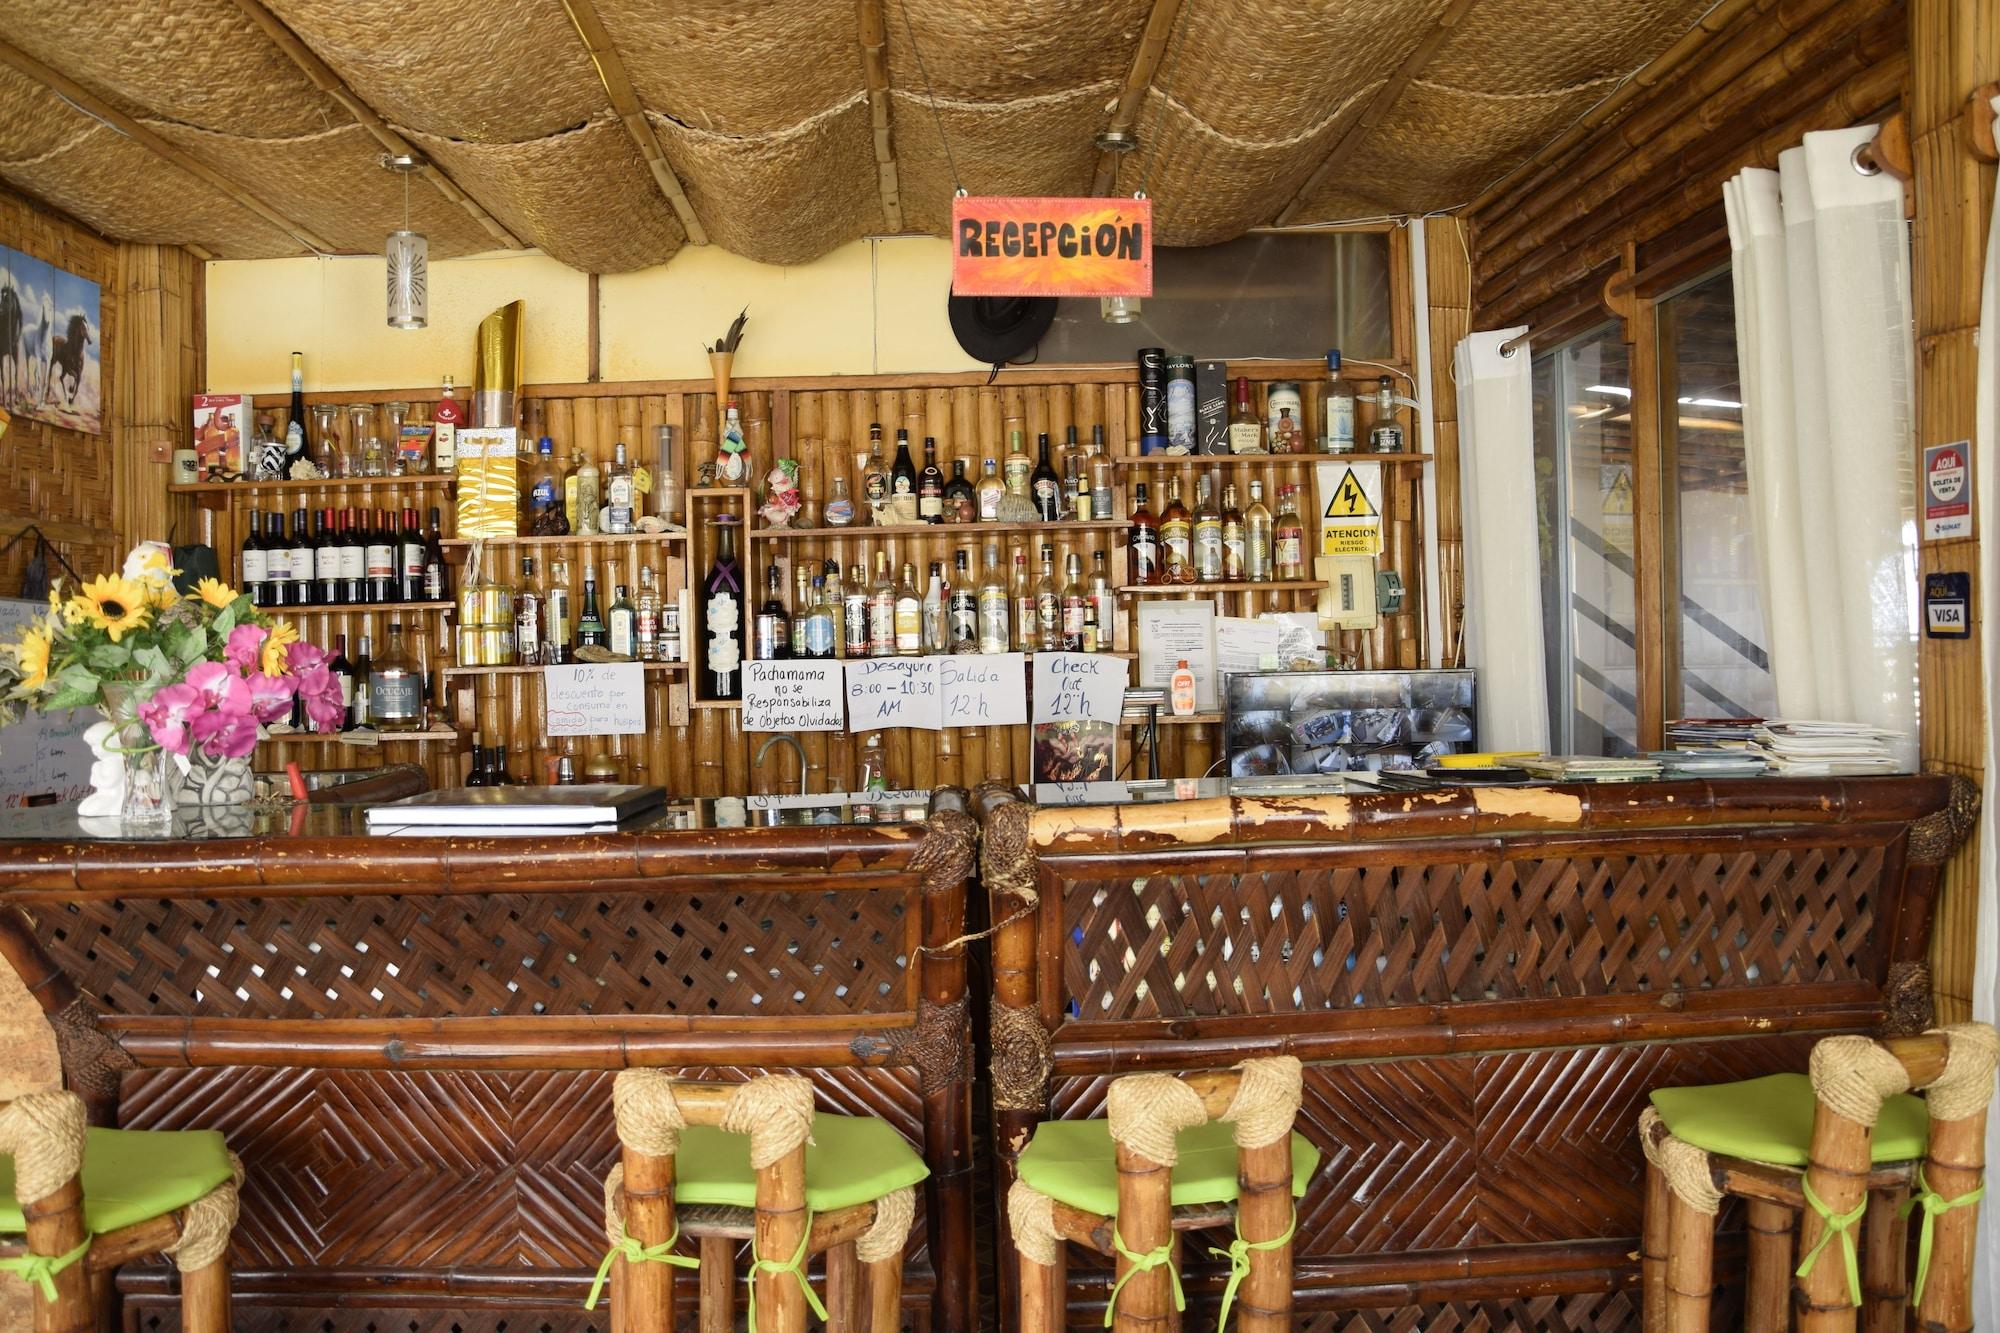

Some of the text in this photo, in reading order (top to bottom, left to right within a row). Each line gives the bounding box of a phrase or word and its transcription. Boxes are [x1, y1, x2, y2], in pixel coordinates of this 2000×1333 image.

[1933, 478, 1953, 487] BOLETA
[1939, 486, 1955, 494] VENTA
[533, 488, 550, 497] AZUL
[1934, 608, 1960, 622] VISA
[748, 662, 825, 682] Pachamama
[860, 661, 934, 678] Desayuno
[940, 659, 999, 685] Salida
[1051, 656, 1099, 674] Check
[573, 667, 616, 682] 10% de
[774, 684, 803, 696] no se
[851, 683, 882, 697] 8:00
[900, 680, 935, 696] 10:30
[1062, 676, 1083, 691] Out
[375, 686, 414, 697] OCUCAJE
[609, 690, 626, 702] por
[747, 693, 831, 714] Responsabiliza
[743, 710, 843, 729] de Objetos Olvidados
